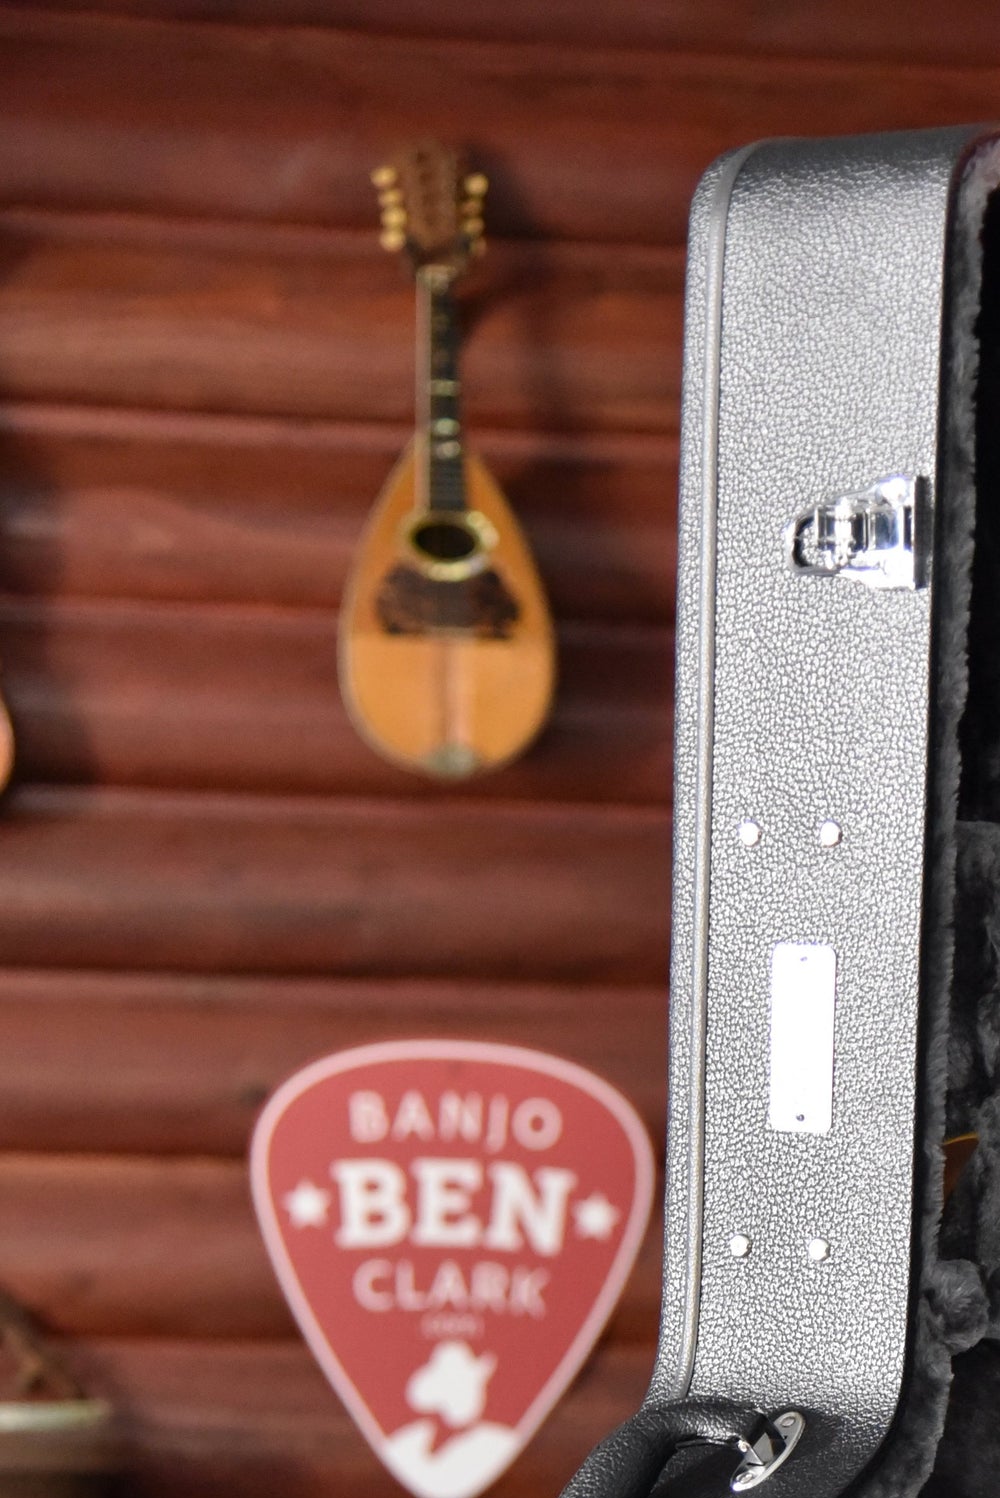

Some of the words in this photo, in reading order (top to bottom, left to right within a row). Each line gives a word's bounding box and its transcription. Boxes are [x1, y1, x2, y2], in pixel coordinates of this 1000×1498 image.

[349, 1091, 563, 1152] BANJO
[332, 1159, 576, 1255] BEN
[353, 1260, 549, 1317] CLARK
